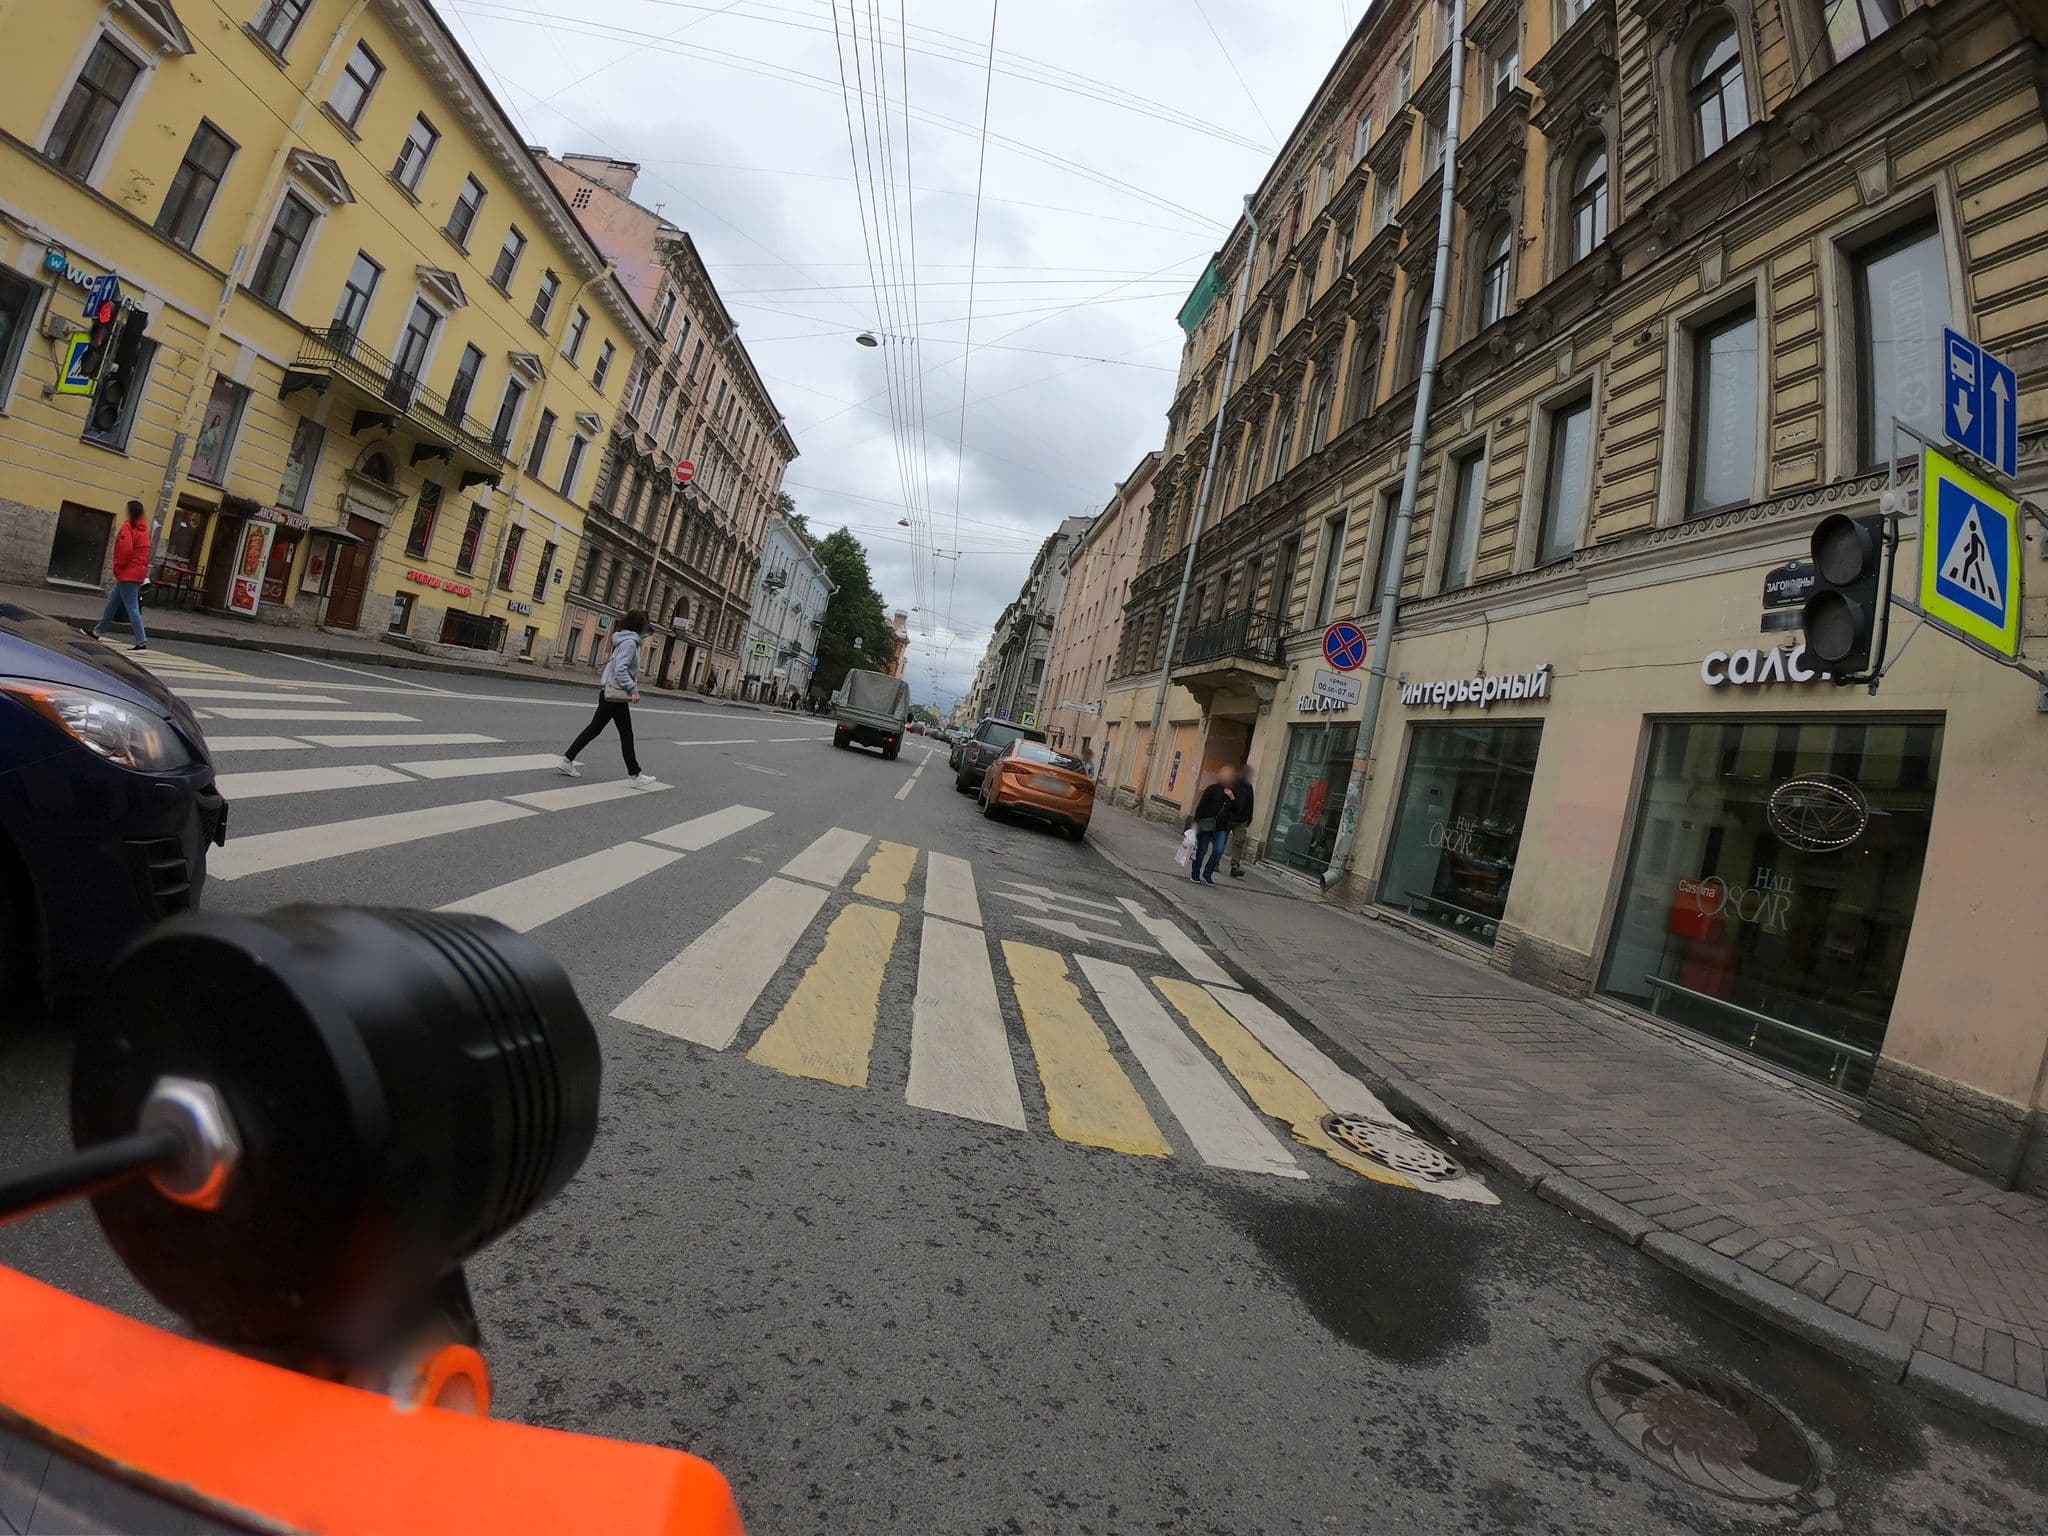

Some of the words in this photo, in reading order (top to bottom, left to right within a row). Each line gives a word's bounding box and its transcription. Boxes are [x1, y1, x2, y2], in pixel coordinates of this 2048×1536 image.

[247, 583, 257, 593] 24
[1701, 642, 1831, 686] сало
[1400, 664, 1552, 710] интерьерный
[1754, 866, 1794, 893] HALL
[1696, 875, 1791, 931] OSCAR
